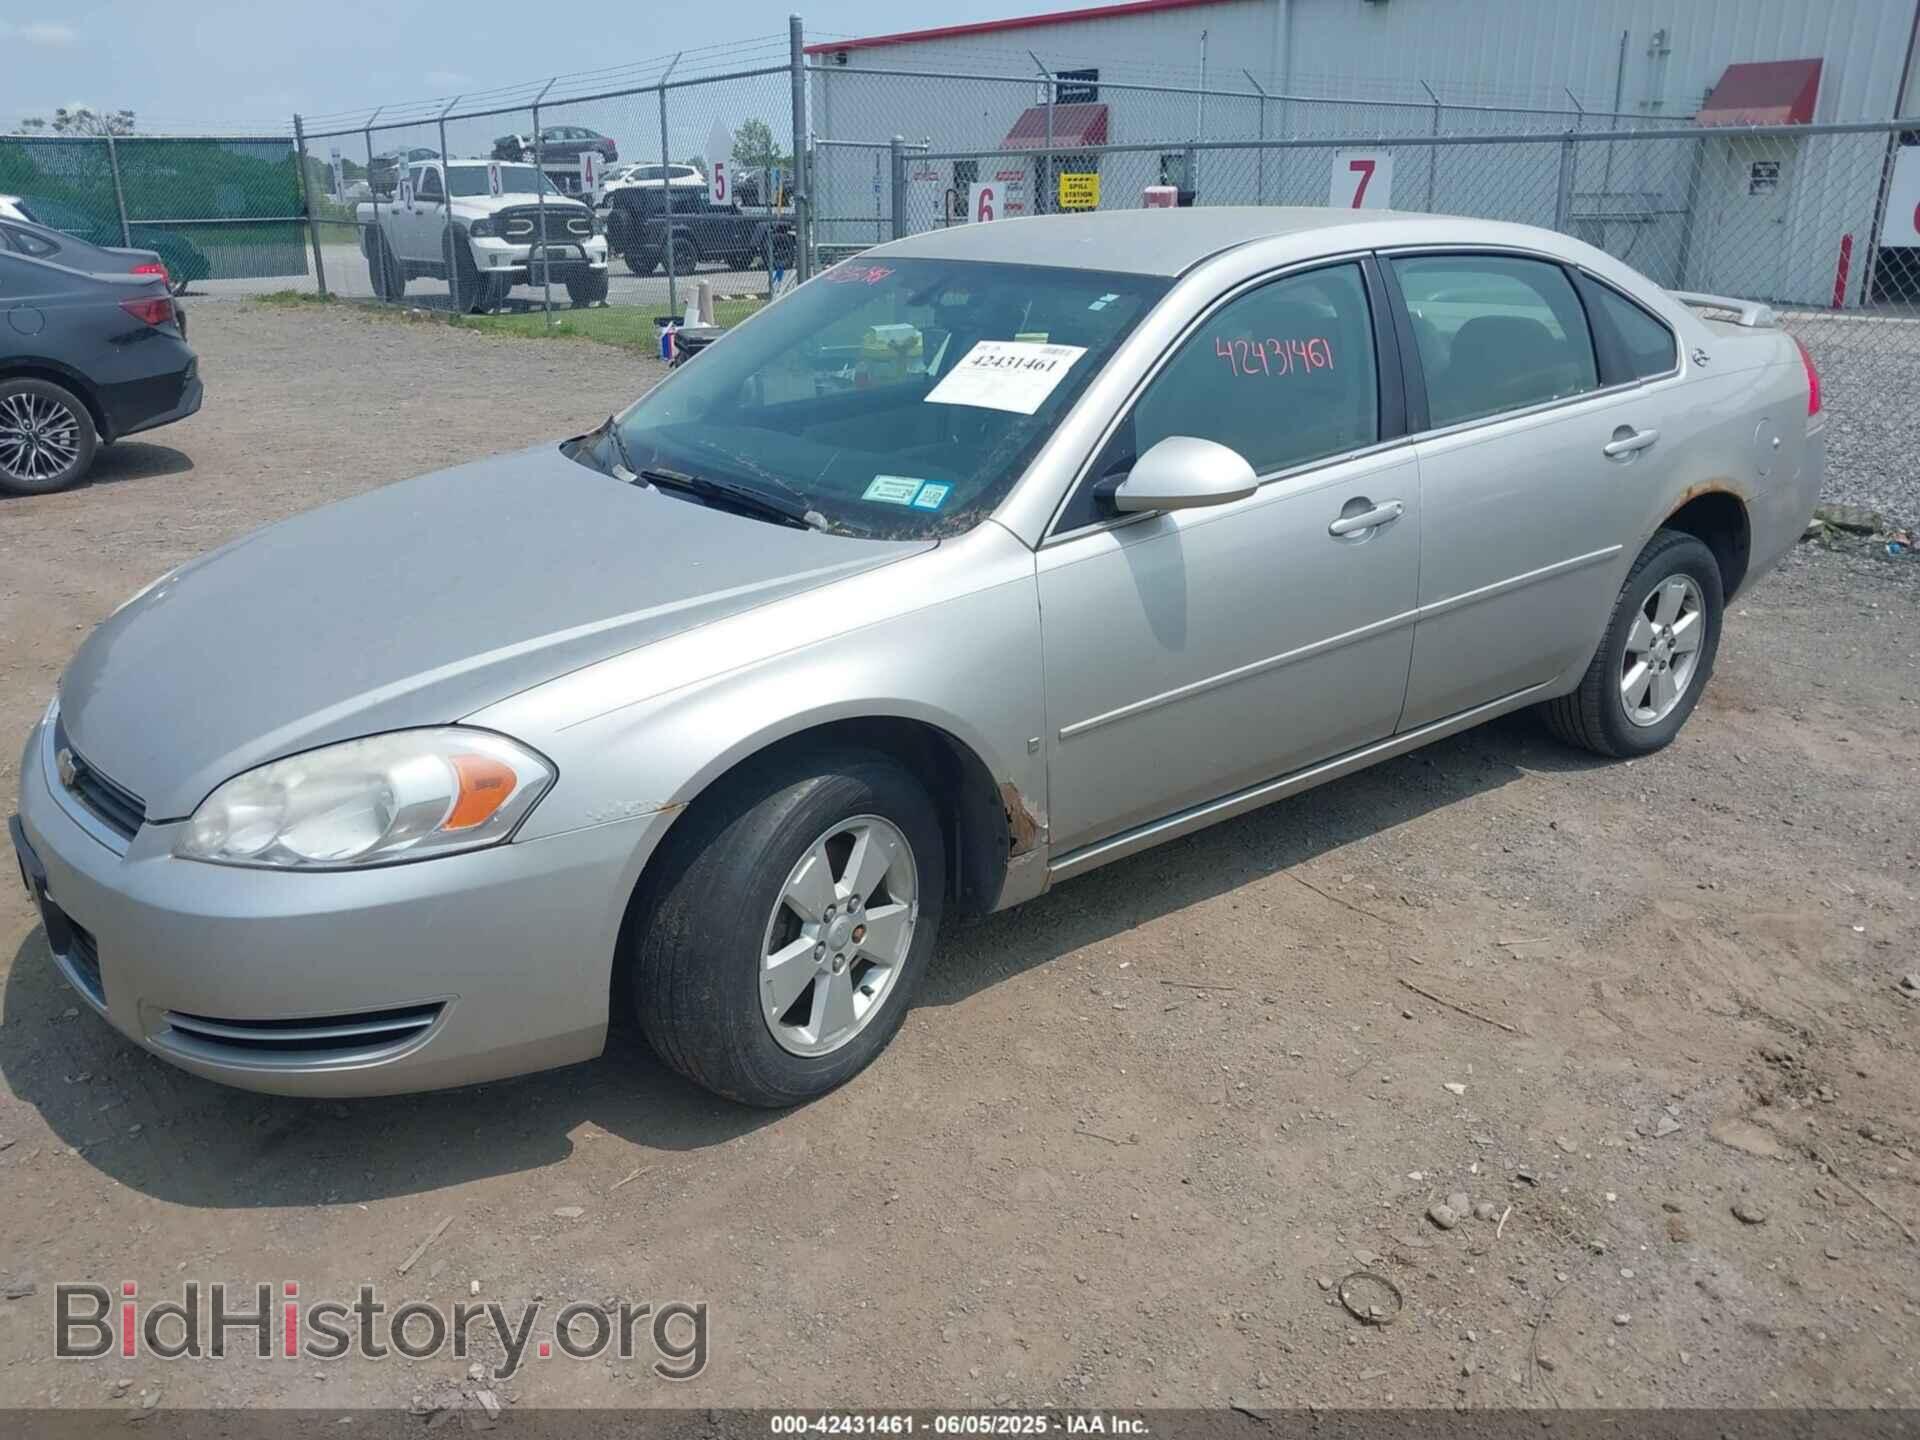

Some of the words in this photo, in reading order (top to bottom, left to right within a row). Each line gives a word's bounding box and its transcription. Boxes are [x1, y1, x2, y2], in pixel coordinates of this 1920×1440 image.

[491, 165, 499, 195] 3
[585, 156, 594, 188] 4
[714, 163, 725, 200] 5
[1349, 160, 1376, 209] 7
[977, 188, 994, 223] 6
[971, 354, 1058, 372] 42431461
[1216, 336, 1334, 376] 42431461
